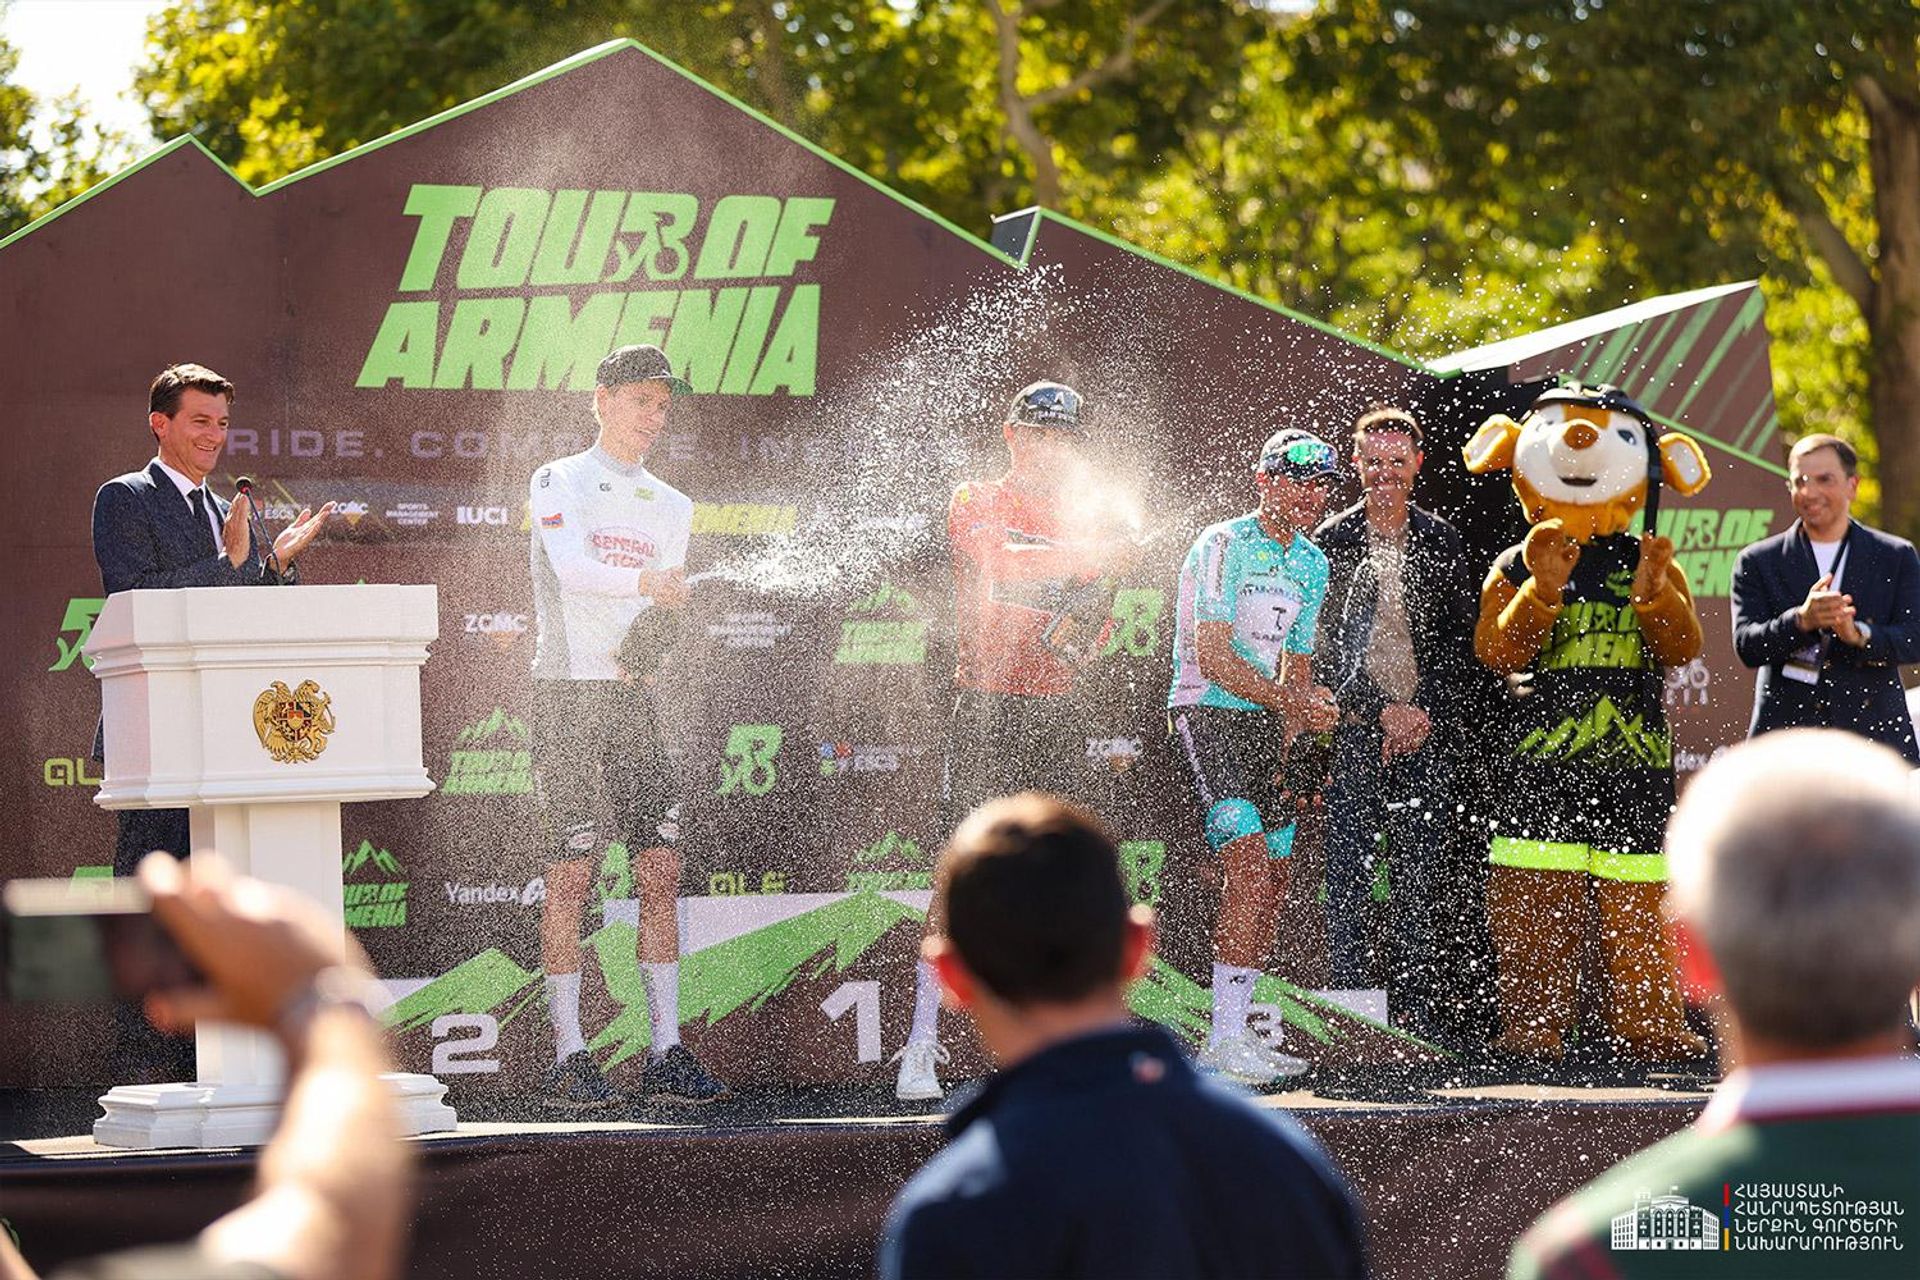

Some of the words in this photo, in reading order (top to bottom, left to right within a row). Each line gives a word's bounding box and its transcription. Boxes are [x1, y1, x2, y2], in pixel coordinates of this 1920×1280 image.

[399, 184, 699, 291] TOUR
[694, 195, 836, 281] OF
[356, 284, 821, 396] ARMENIA
[227, 427, 384, 459] RIDE.
[446, 880, 520, 904] Yandex
[431, 1013, 499, 1074] 2
[820, 980, 881, 1063] 1
